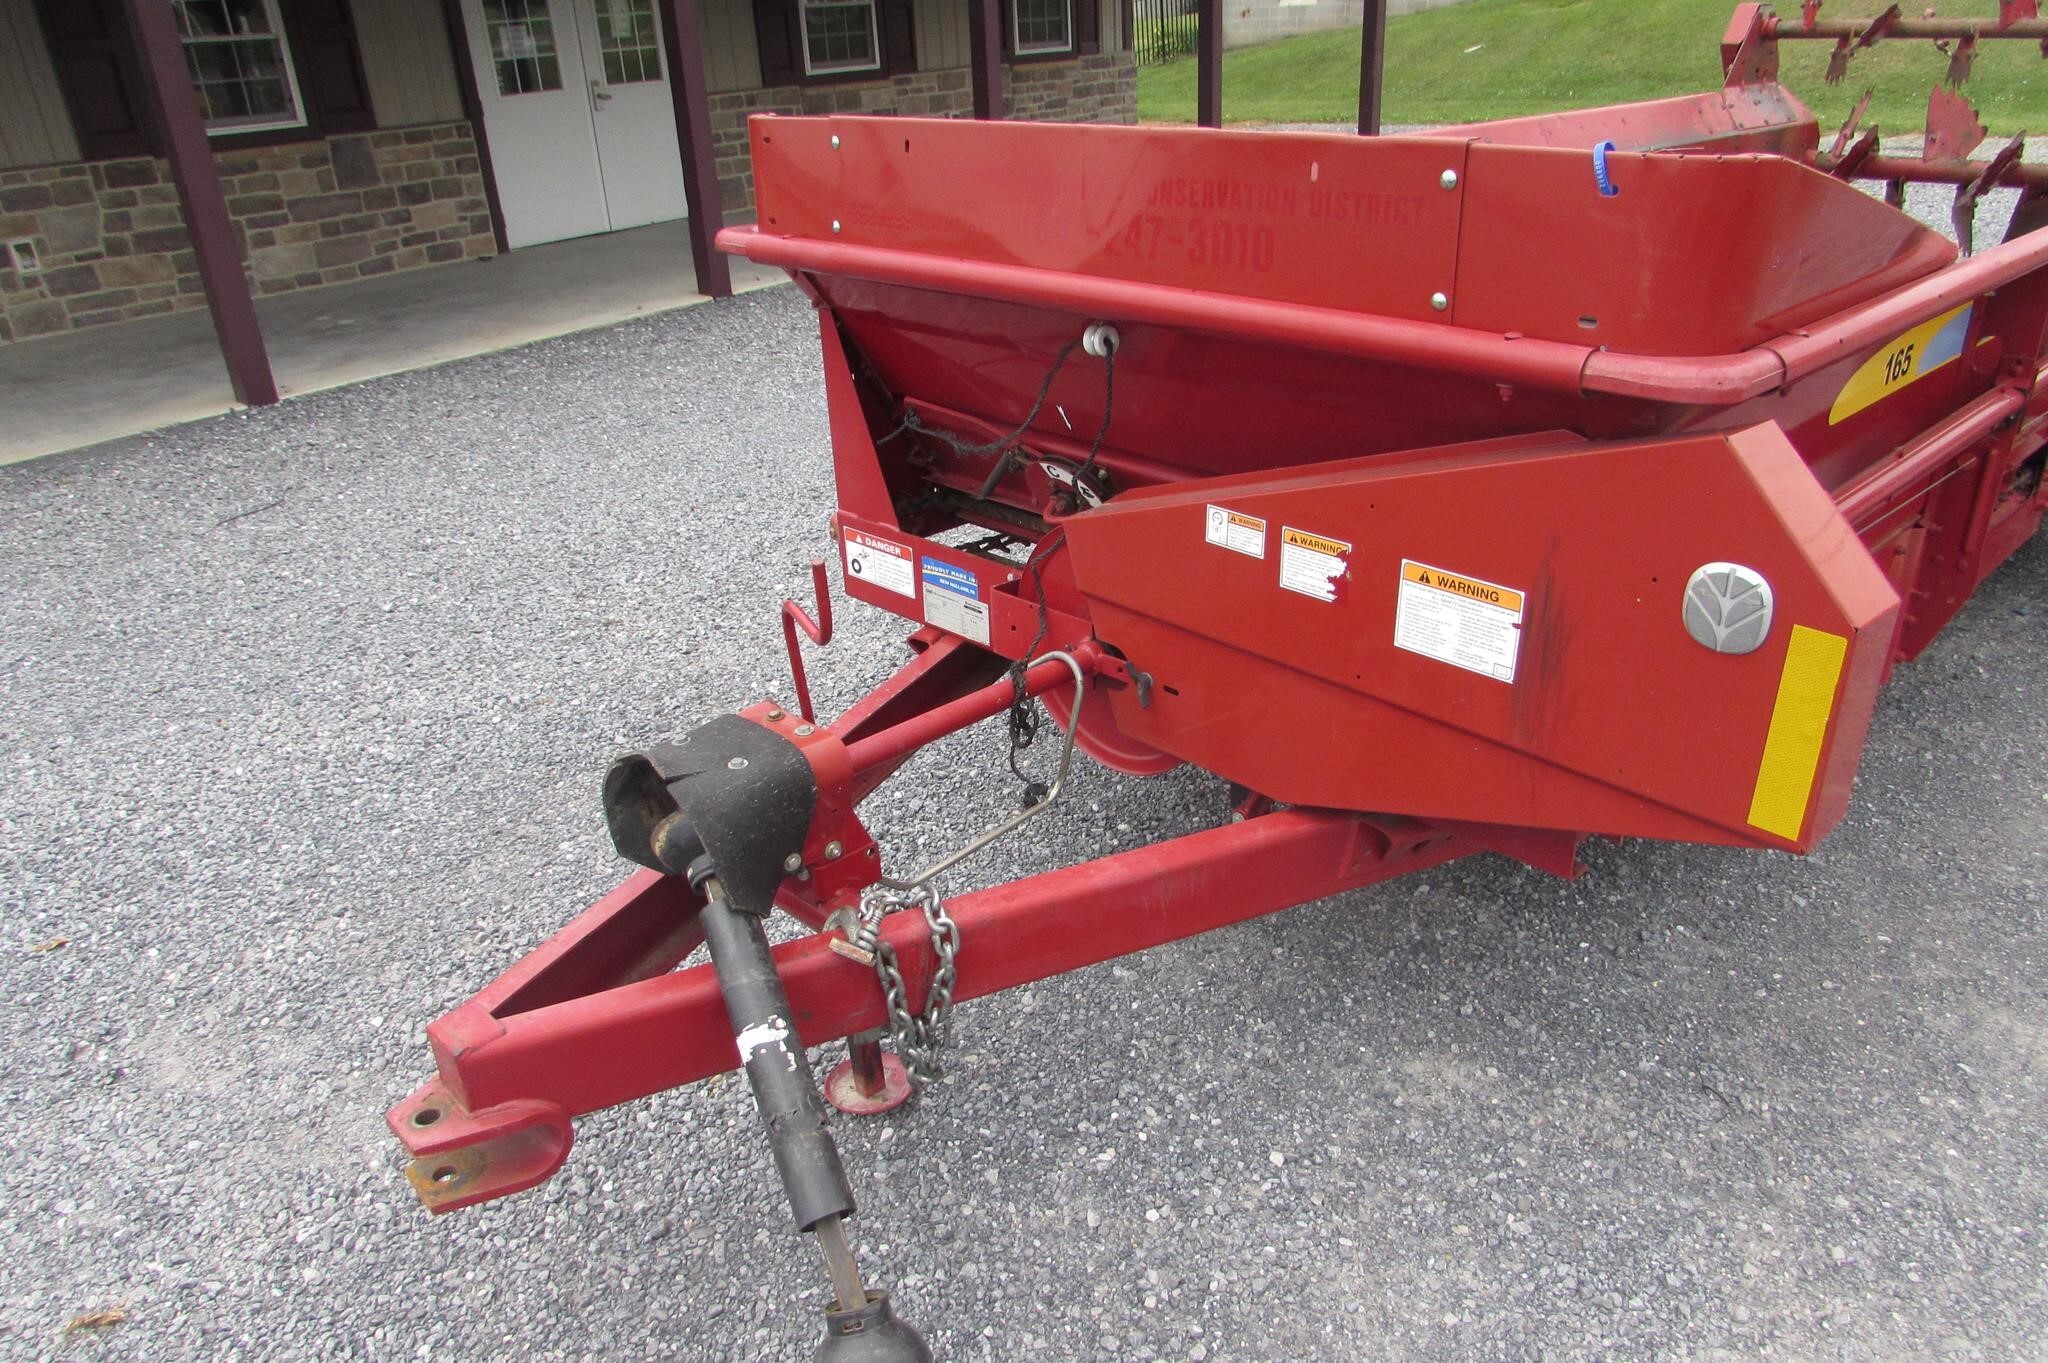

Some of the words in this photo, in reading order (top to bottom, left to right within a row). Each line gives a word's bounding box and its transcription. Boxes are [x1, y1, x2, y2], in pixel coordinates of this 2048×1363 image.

[1309, 188, 1428, 226] DISTRICT
[1884, 344, 1914, 386] 165
[1238, 517, 1262, 529] WARNING
[865, 537, 902, 555] DANGER
[1300, 536, 1342, 554] WARNING
[1437, 575, 1500, 603] WARNING
